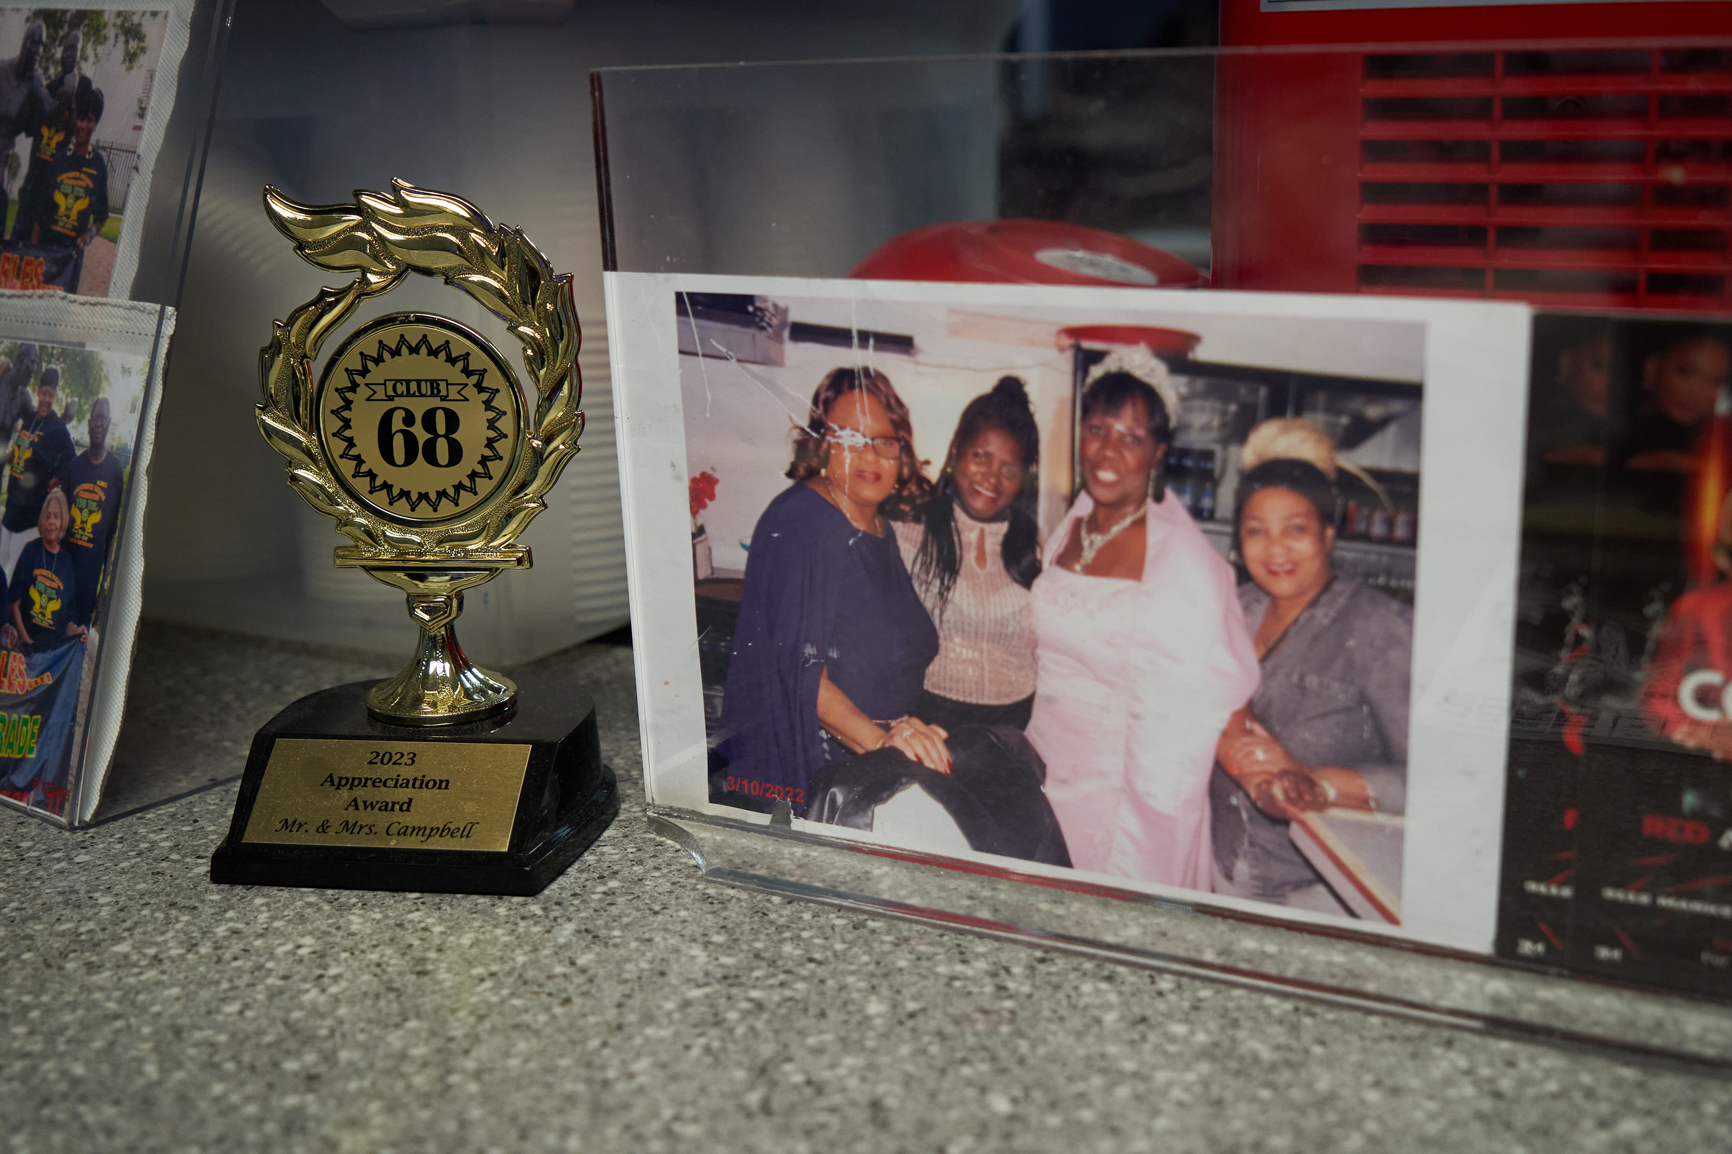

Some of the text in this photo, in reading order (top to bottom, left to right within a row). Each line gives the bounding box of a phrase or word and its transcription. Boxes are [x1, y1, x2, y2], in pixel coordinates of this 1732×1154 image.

[391, 381, 442, 396] CLUB
[377, 406, 464, 468] 68
[1677, 669, 1732, 722] C
[366, 751, 417, 767] 2023
[319, 772, 450, 791] Appreciation
[726, 776, 805, 803] 3/10/2022
[344, 797, 413, 813] Award
[274, 818, 480, 843] Mr. & Mrs. Campbell
